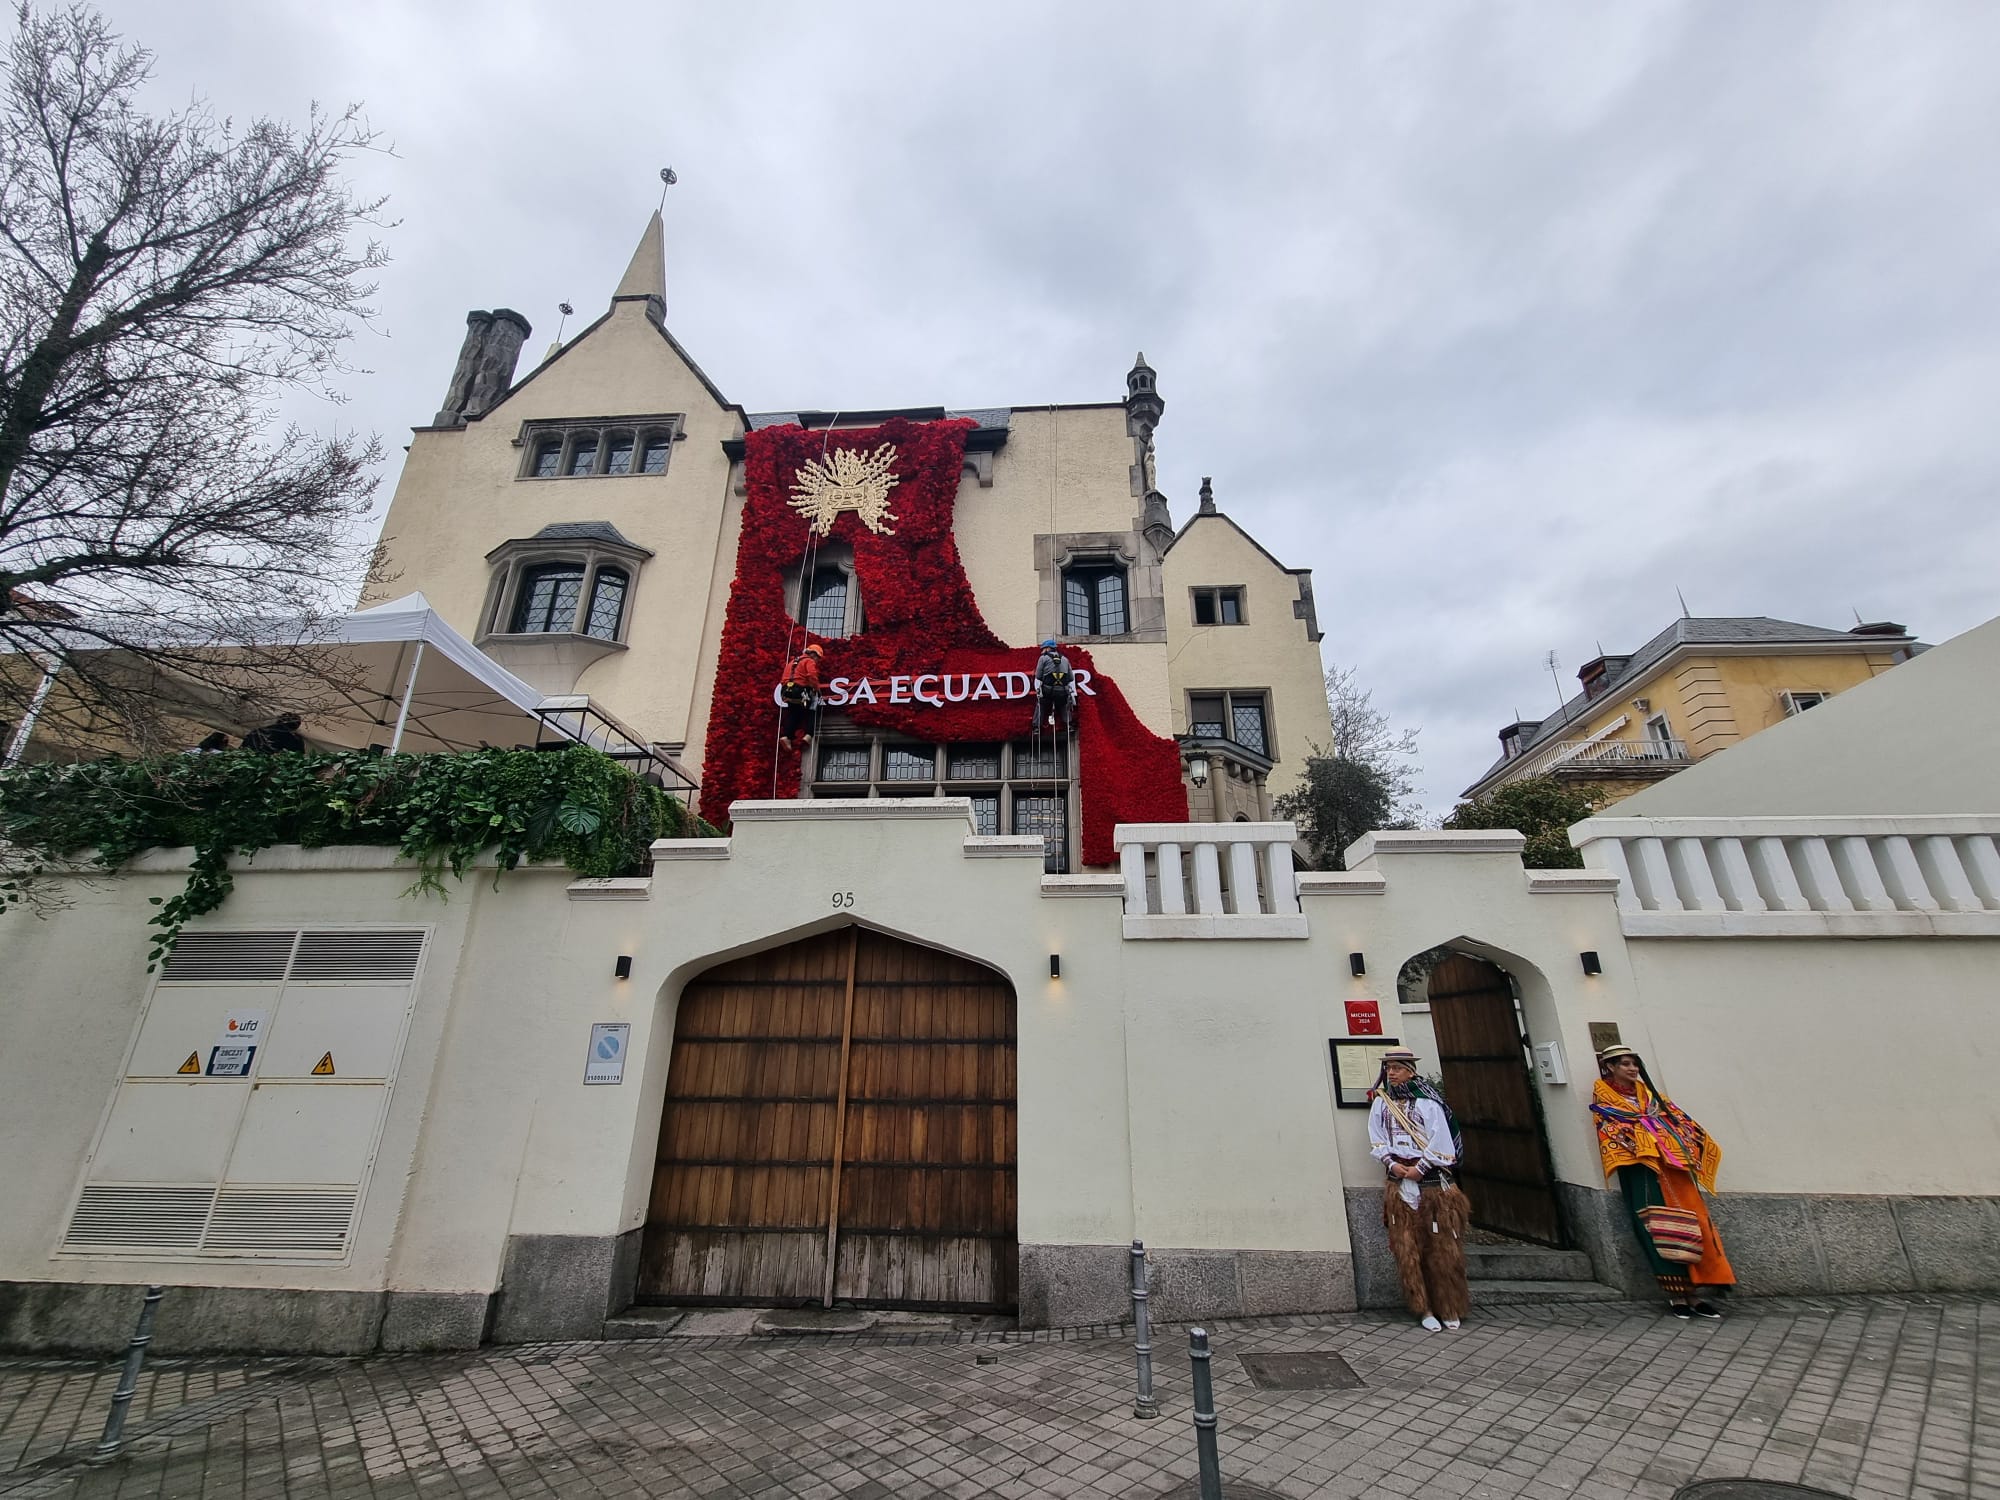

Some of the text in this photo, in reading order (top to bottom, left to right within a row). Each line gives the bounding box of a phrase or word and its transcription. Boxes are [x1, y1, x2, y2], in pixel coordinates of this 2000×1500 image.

[773, 677, 878, 707] CSA
[832, 892, 854, 908] 95
[239, 1020, 259, 1031] ufd
